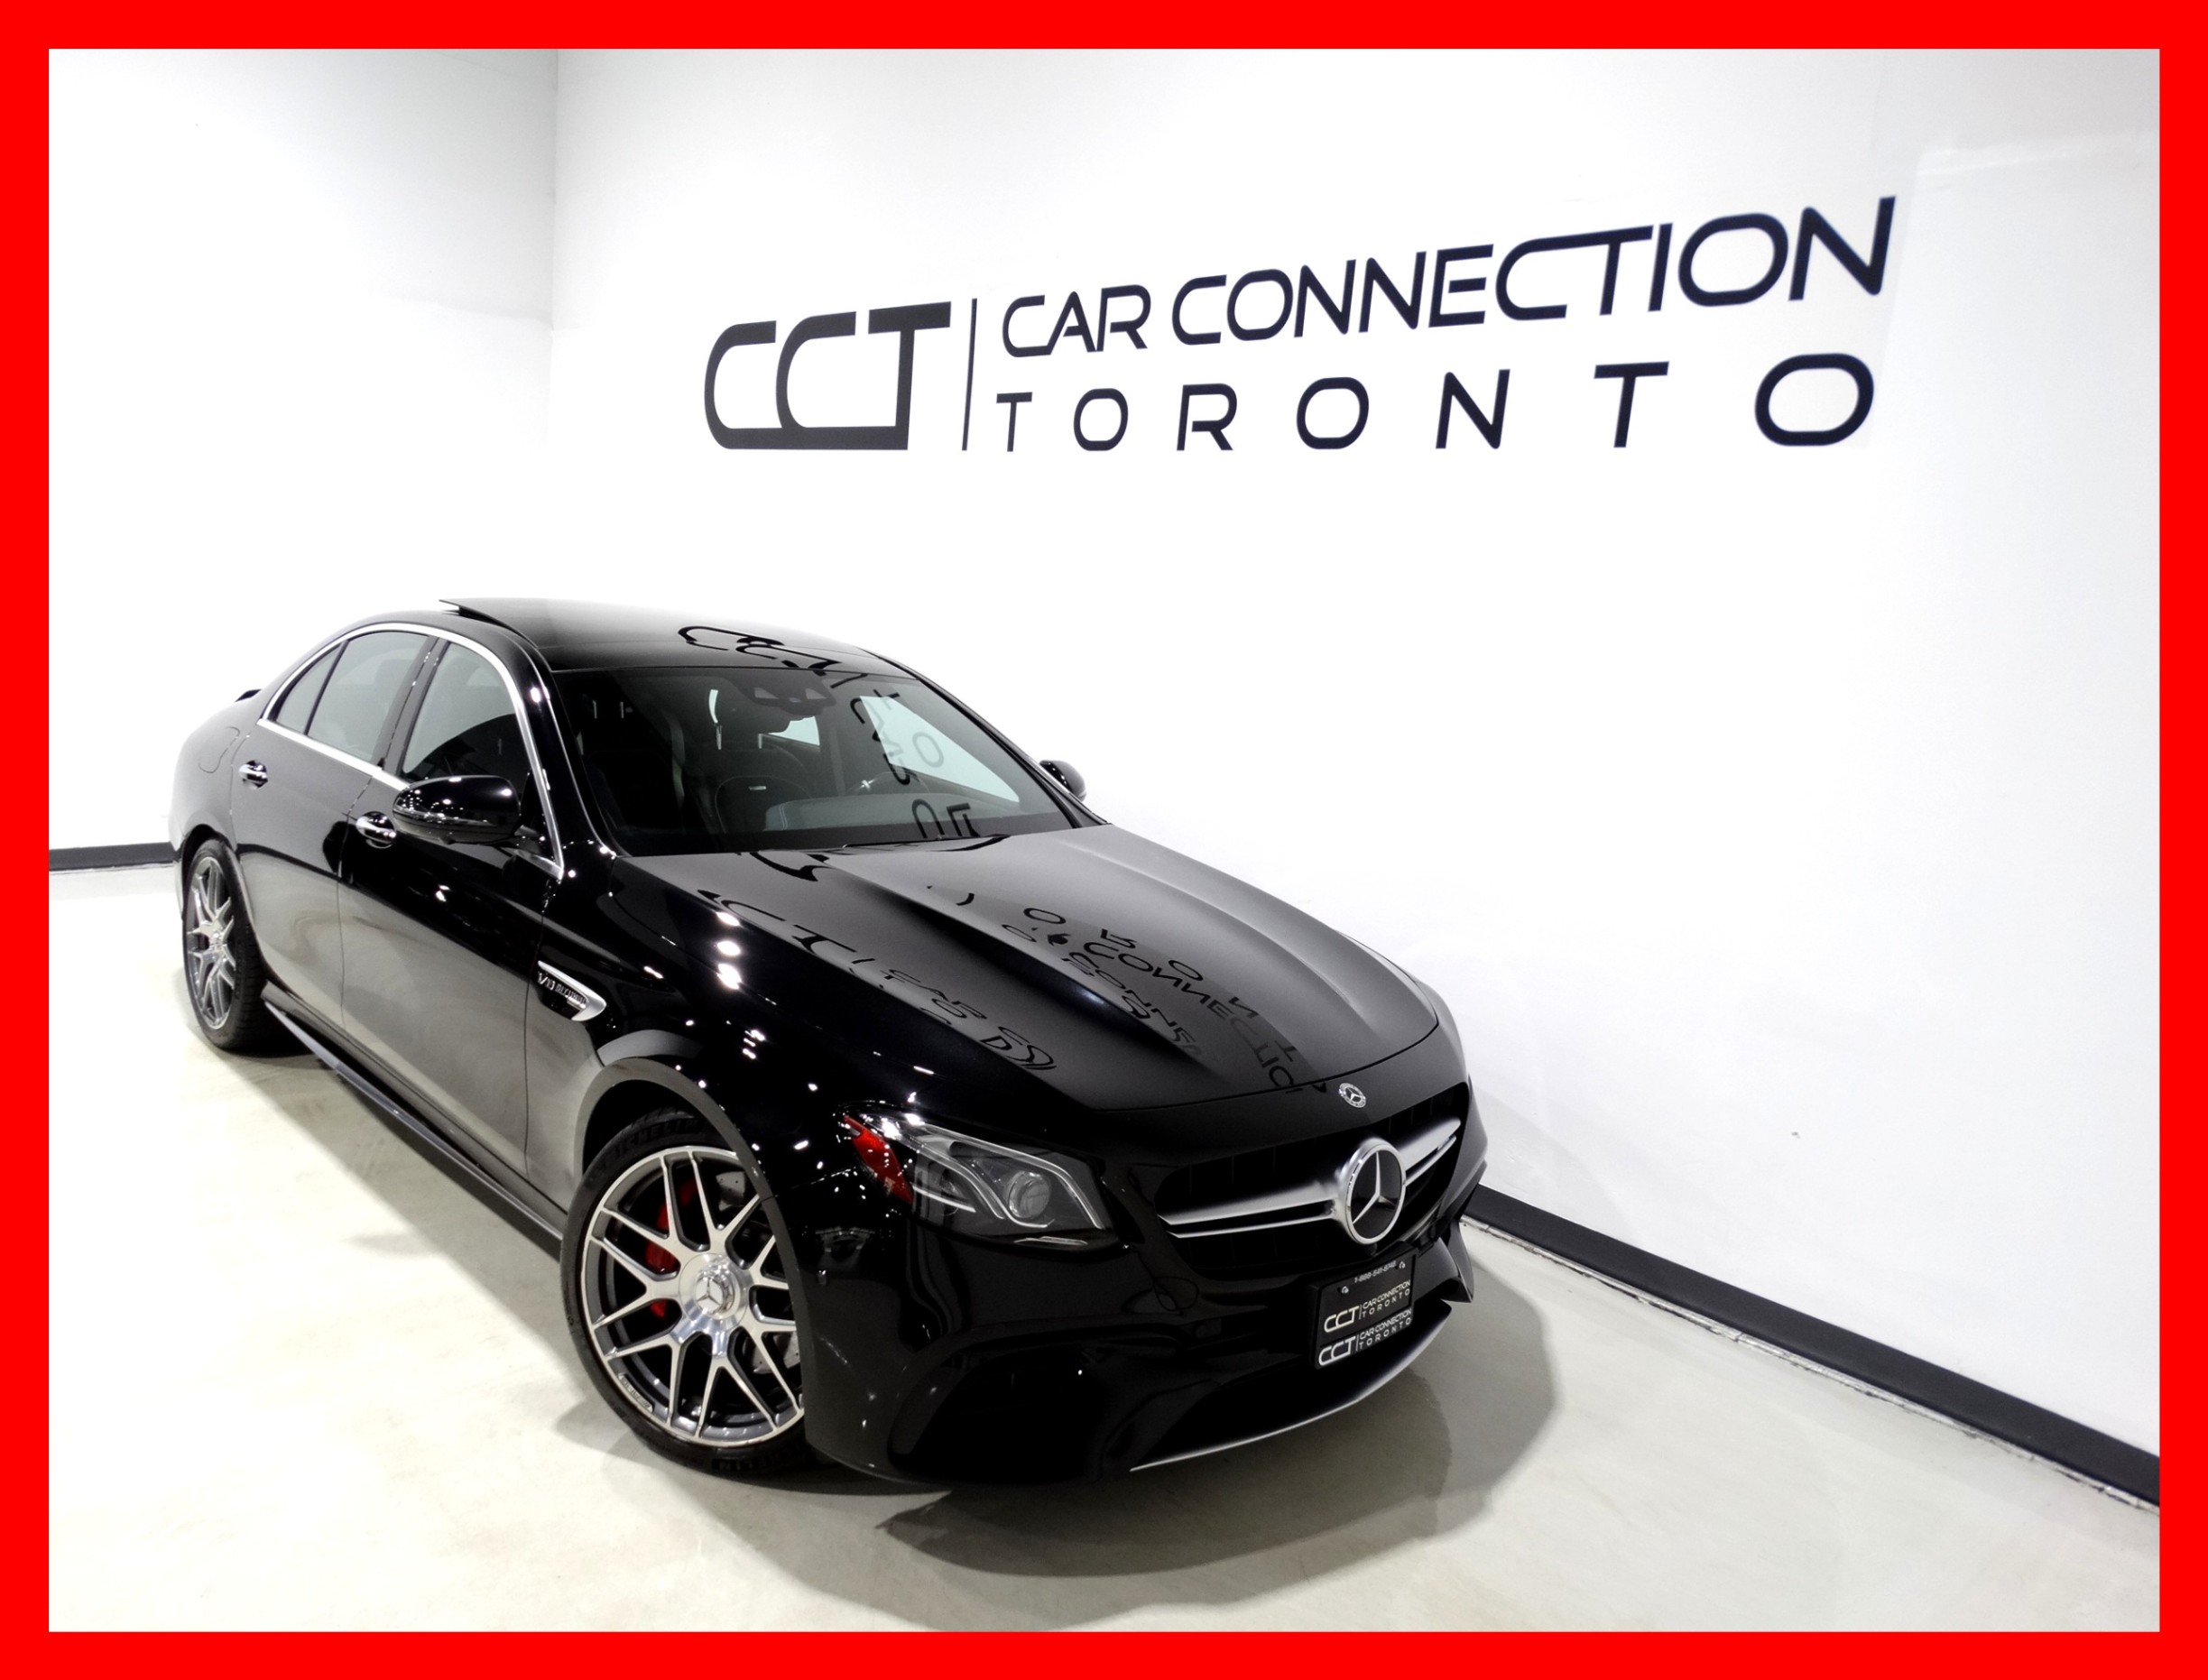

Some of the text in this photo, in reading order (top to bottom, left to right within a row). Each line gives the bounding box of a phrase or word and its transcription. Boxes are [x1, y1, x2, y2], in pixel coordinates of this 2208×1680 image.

[1002, 196, 1896, 358] CAR CONNECTION
[704, 301, 952, 450] CCT
[996, 353, 1874, 452] TORONTO
[1362, 1288, 1410, 1318] TORONTO
[1363, 1279, 1410, 1309] CAR CONNECTION
[1324, 1306, 1359, 1333] CCT
[1358, 1317, 1412, 1350] TORONTO
[1359, 1308, 1412, 1340] CAR CONNECTION
[1318, 1336, 1356, 1366] CCT
